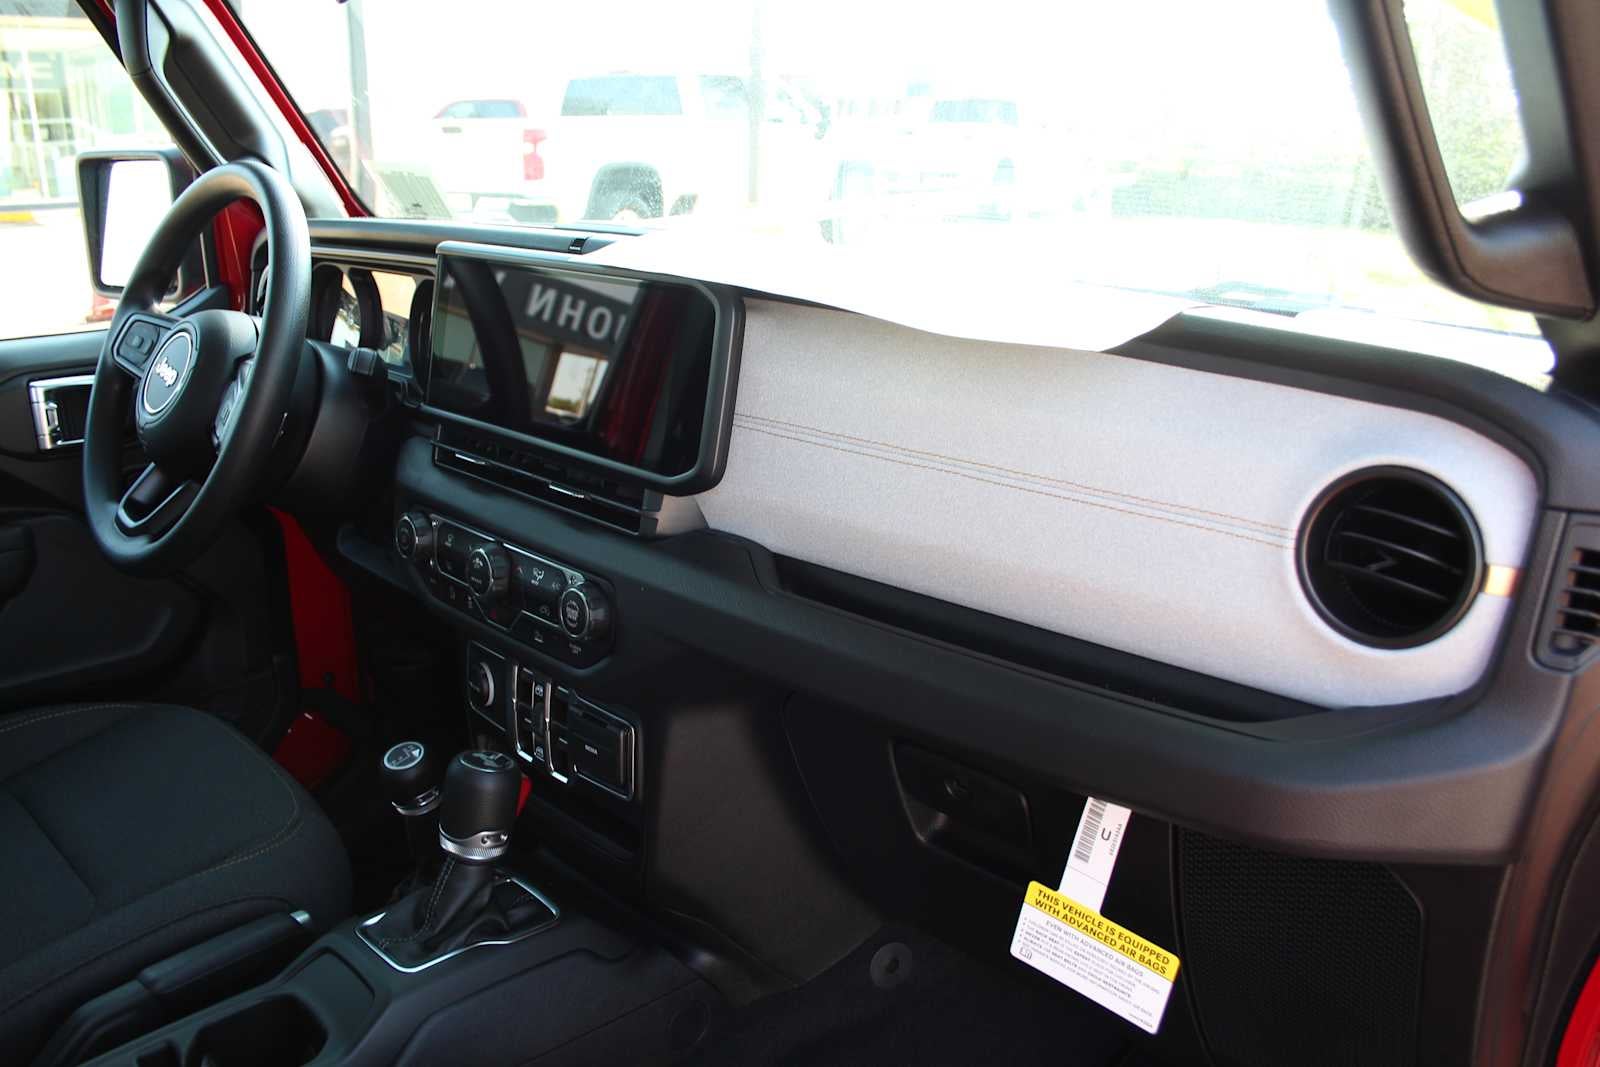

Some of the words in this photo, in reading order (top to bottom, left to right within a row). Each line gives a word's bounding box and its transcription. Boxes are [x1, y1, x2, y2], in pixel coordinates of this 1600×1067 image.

[1034, 896, 1060, 916] WITH
[1061, 911, 1117, 947] ADVANCED
[1118, 942, 1136, 958] AIR
[1138, 953, 1166, 975] BAGS
[1037, 888, 1059, 906] THIS
[1061, 901, 1104, 930] VEHICLE
[1105, 925, 1115, 936] IS
[1117, 932, 1169, 966] EQUIPPED
[1080, 938, 1113, 960] ADVANCED
